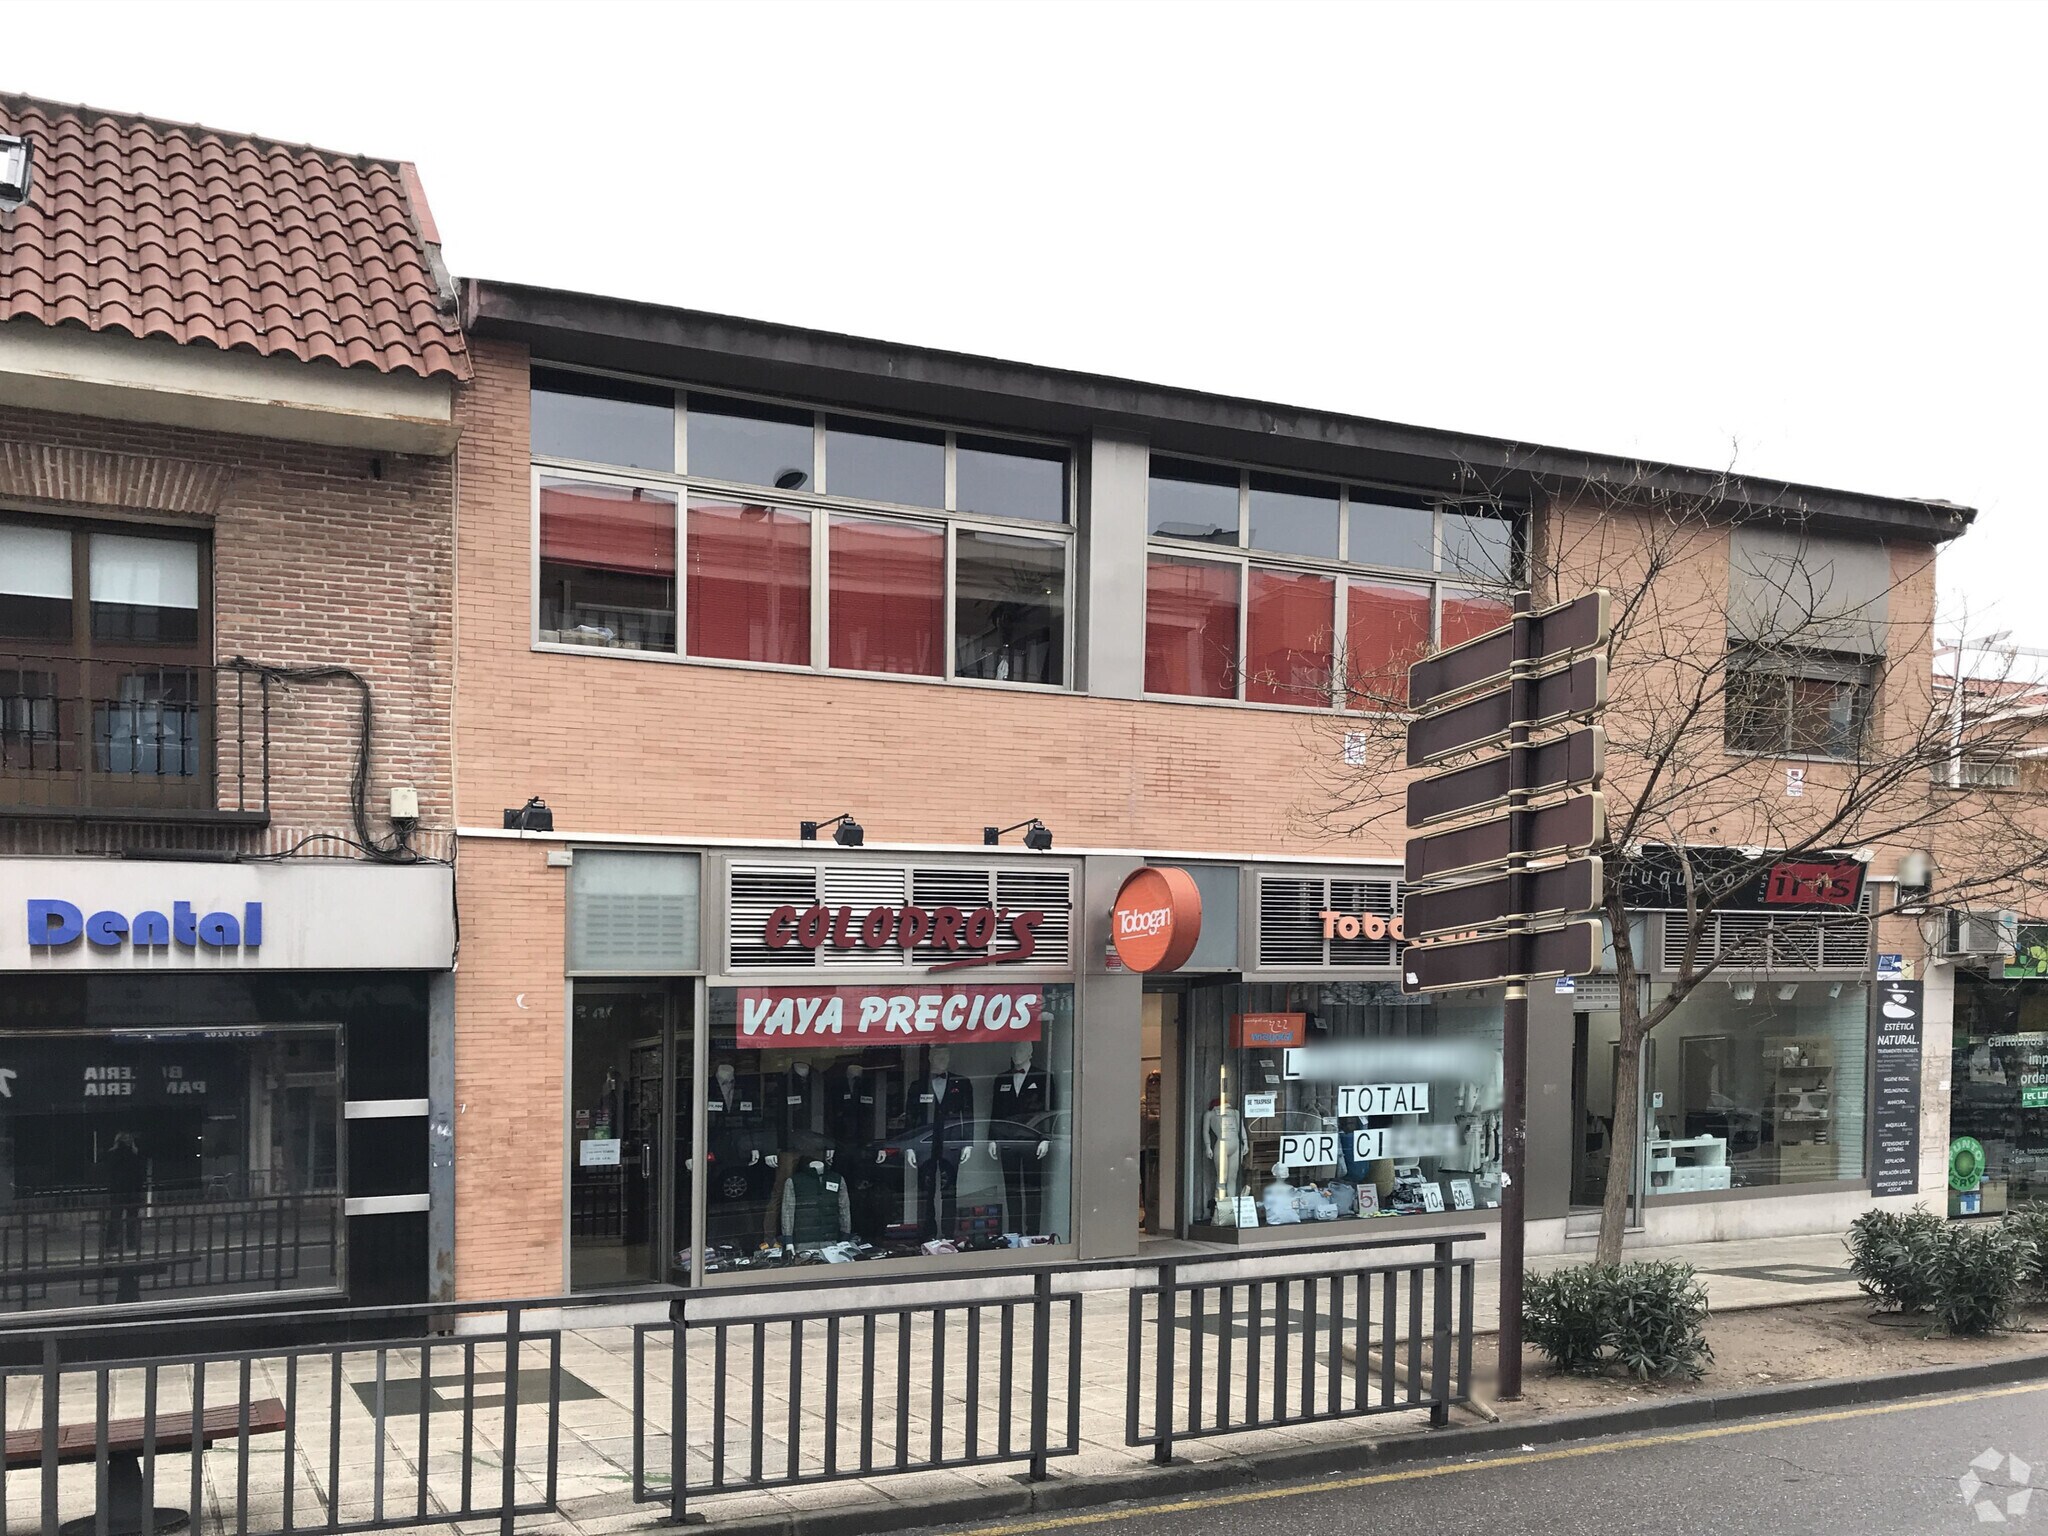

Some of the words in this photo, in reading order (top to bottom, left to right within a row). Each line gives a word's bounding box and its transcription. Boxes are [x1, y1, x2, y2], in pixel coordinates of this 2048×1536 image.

[27, 899, 262, 946] Dental
[1117, 907, 1171, 936] Tobogan
[765, 905, 1045, 972] COLODRO'S
[743, 997, 844, 1035] VAYA
[858, 993, 1038, 1035] PRECIOS
[1884, 1021, 1914, 1031] ESTÉTICA
[1877, 1035, 1920, 1046] NATURAL.
[2020, 1071, 2048, 1085] orde
[1341, 1086, 1426, 1114] TOTAL
[1282, 1136, 1334, 1164] POR
